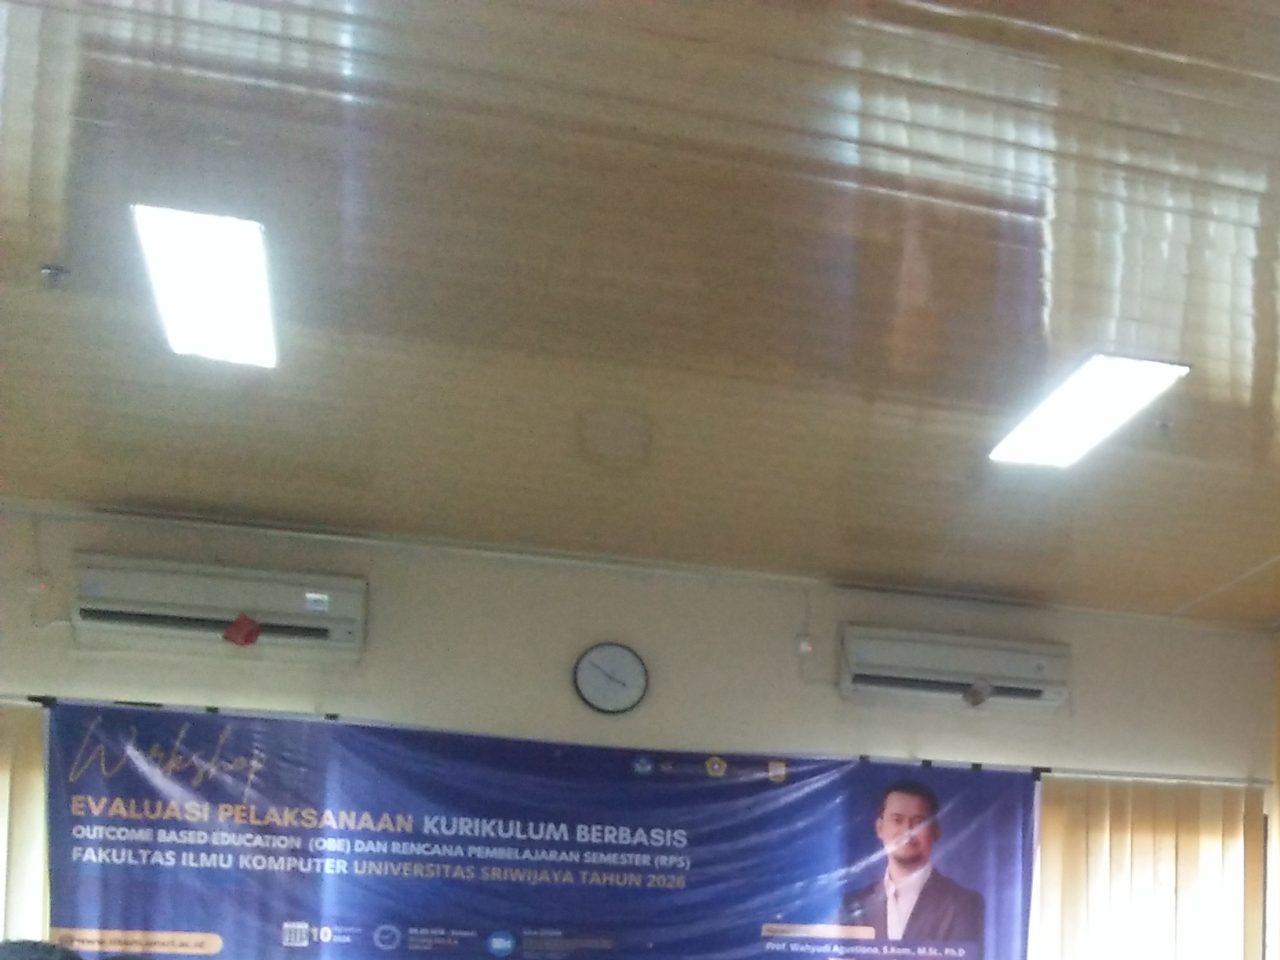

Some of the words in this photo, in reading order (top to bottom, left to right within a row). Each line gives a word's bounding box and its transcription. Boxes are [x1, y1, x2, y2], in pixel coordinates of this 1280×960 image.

[71, 795, 210, 822] EVALUASI
[217, 803, 414, 833] PELAKSANAAN
[423, 815, 569, 841] KURIKULUM
[576, 824, 688, 848] BERBASIS
[72, 825, 153, 842] OUTCOME
[157, 828, 208, 844] BASED
[211, 831, 302, 849] EDUCATION
[308, 836, 351, 853] (OBE)
[354, 839, 389, 854] DAN
[391, 841, 464, 858] RENCANA
[468, 845, 580, 863] PEMBELAJARAN
[583, 851, 651, 867] SEMESTER
[654, 854, 691, 871] (RPS)
[72, 846, 176, 867] FAKULTAS
[181, 851, 233, 869] ILMU
[239, 854, 348, 875] KOMPUTER
[354, 860, 475, 880] UNIVERSITAS
[480, 866, 574, 886] SRIWIJAYA
[581, 870, 642, 887] TAHUN
[646, 874, 687, 889] 2026
[310, 925, 333, 944] 10
